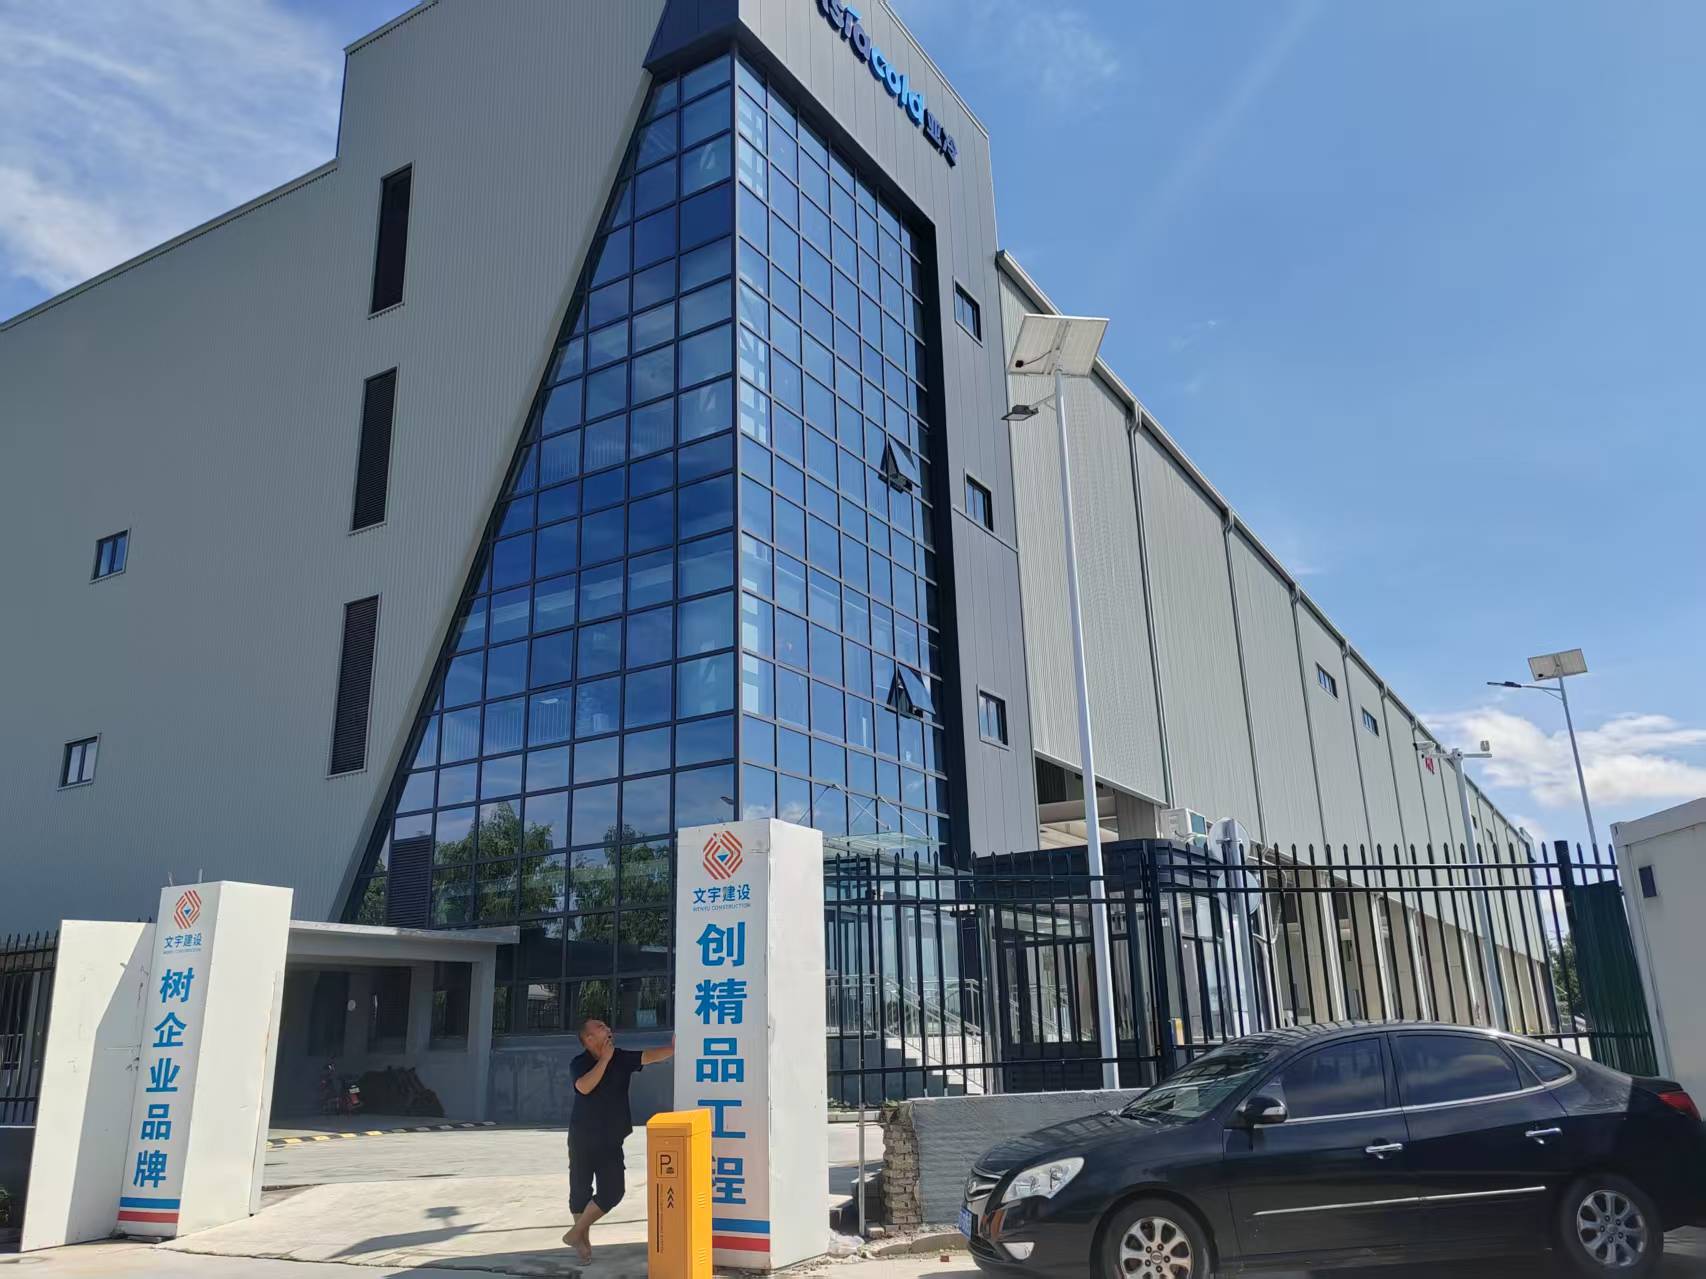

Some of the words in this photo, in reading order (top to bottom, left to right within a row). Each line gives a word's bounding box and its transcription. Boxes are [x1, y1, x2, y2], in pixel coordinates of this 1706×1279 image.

[816, 0, 923, 127] siacold
[925, 110, 958, 168] 亚冷
[693, 884, 751, 904] 文宇建设
[164, 933, 202, 949] 文宇建设
[133, 967, 195, 1188] 树企业品牌
[695, 921, 747, 1205] 创精品工程
